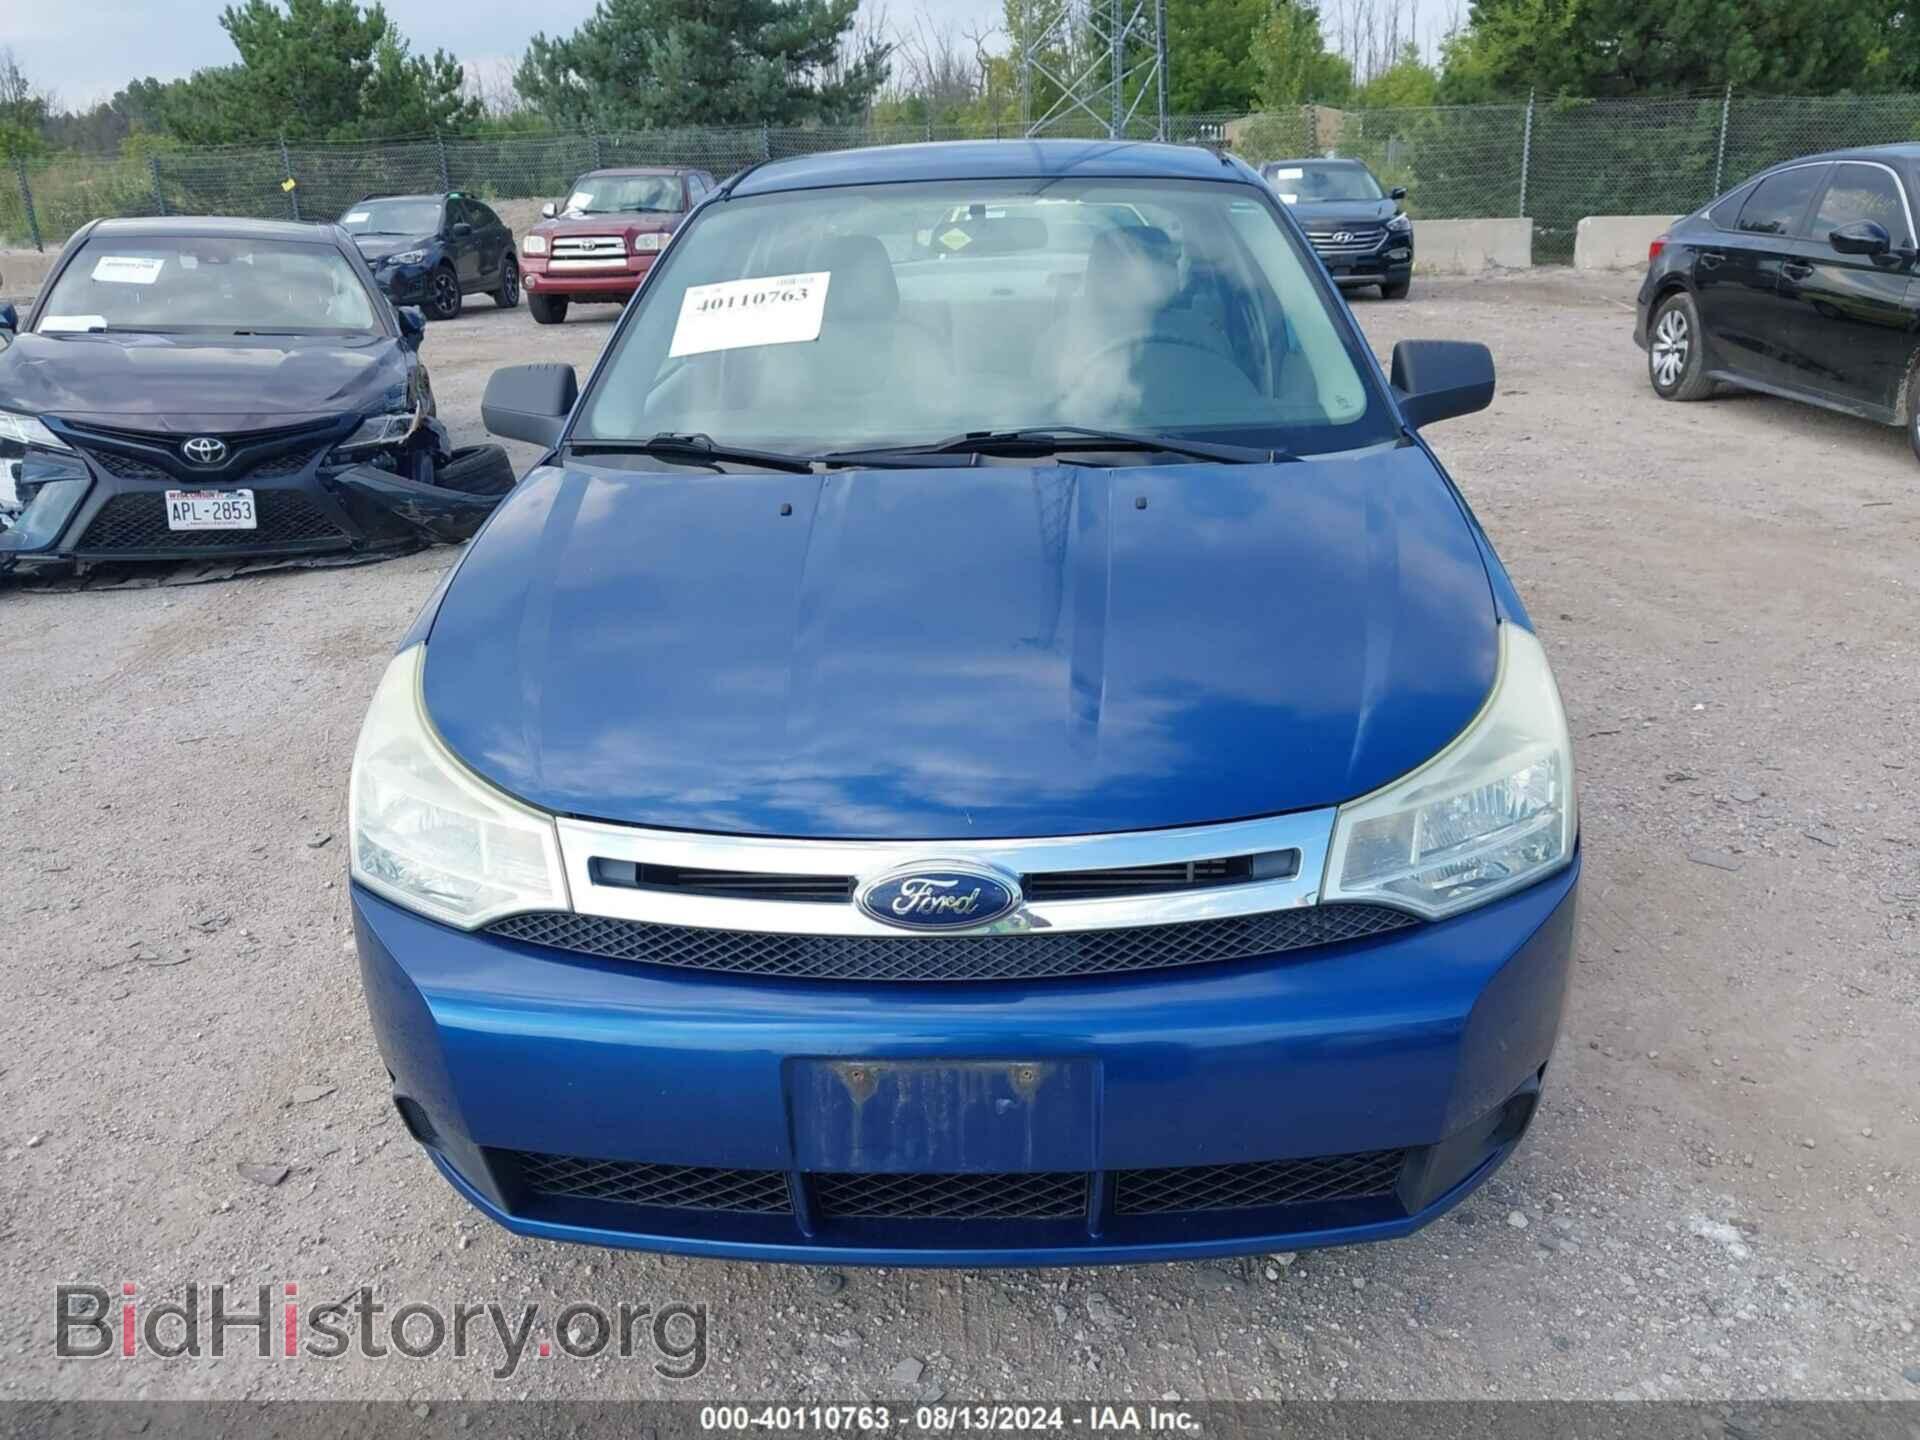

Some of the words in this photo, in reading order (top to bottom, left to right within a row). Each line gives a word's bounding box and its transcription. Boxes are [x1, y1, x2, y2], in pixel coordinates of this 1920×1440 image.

[696, 288, 809, 313] 40110763
[172, 500, 253, 521] APL-2853
[892, 877, 981, 915] Ford
